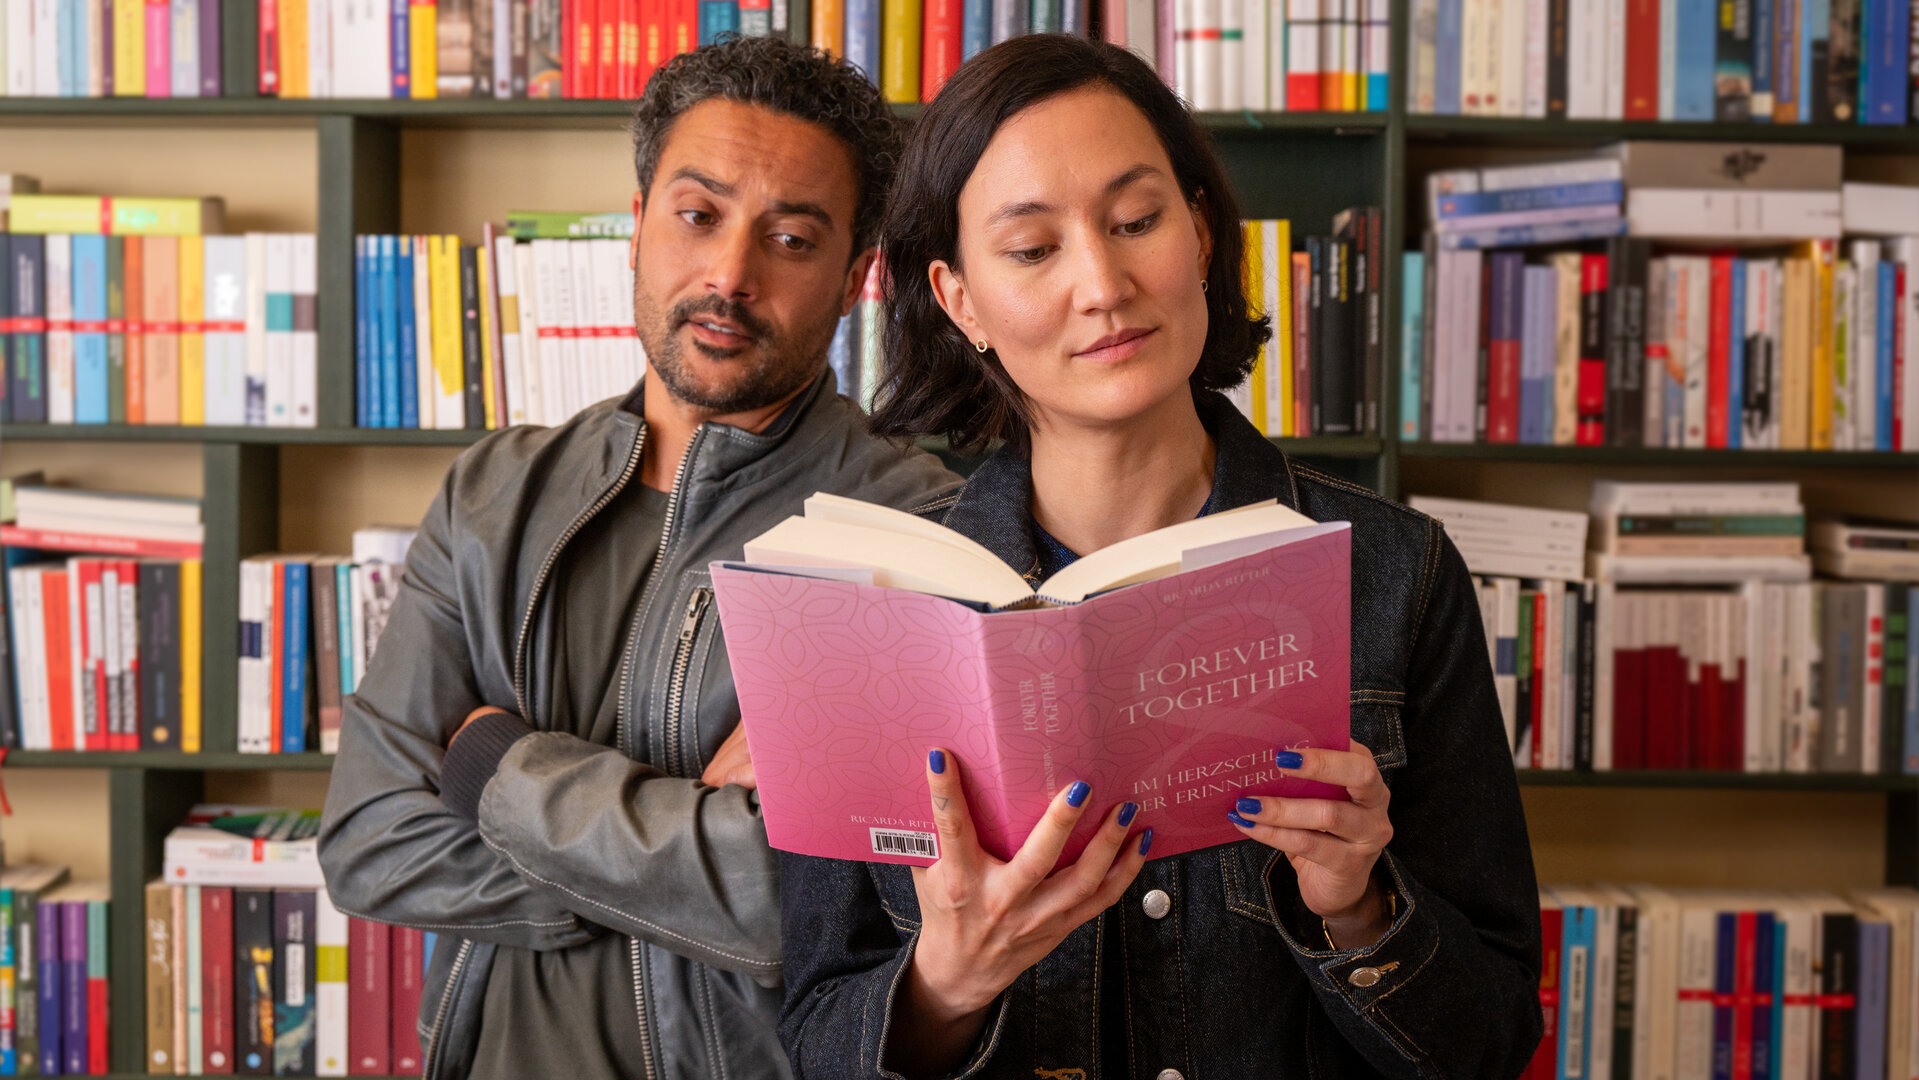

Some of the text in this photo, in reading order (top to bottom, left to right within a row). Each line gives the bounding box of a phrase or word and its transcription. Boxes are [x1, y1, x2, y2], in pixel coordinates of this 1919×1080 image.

[1163, 580, 1221, 604] RICARDA
[1138, 633, 1299, 692] FOREVER
[1018, 679, 1039, 731] FOREVER
[1040, 671, 1061, 736] TOGETHER
[1119, 659, 1319, 725] TOGETHER
[1132, 739, 1310, 795] IM HERZSCHLG
[1139, 769, 1284, 813] ER ERINNERU
[850, 815, 936, 830] RICARDA RITT
